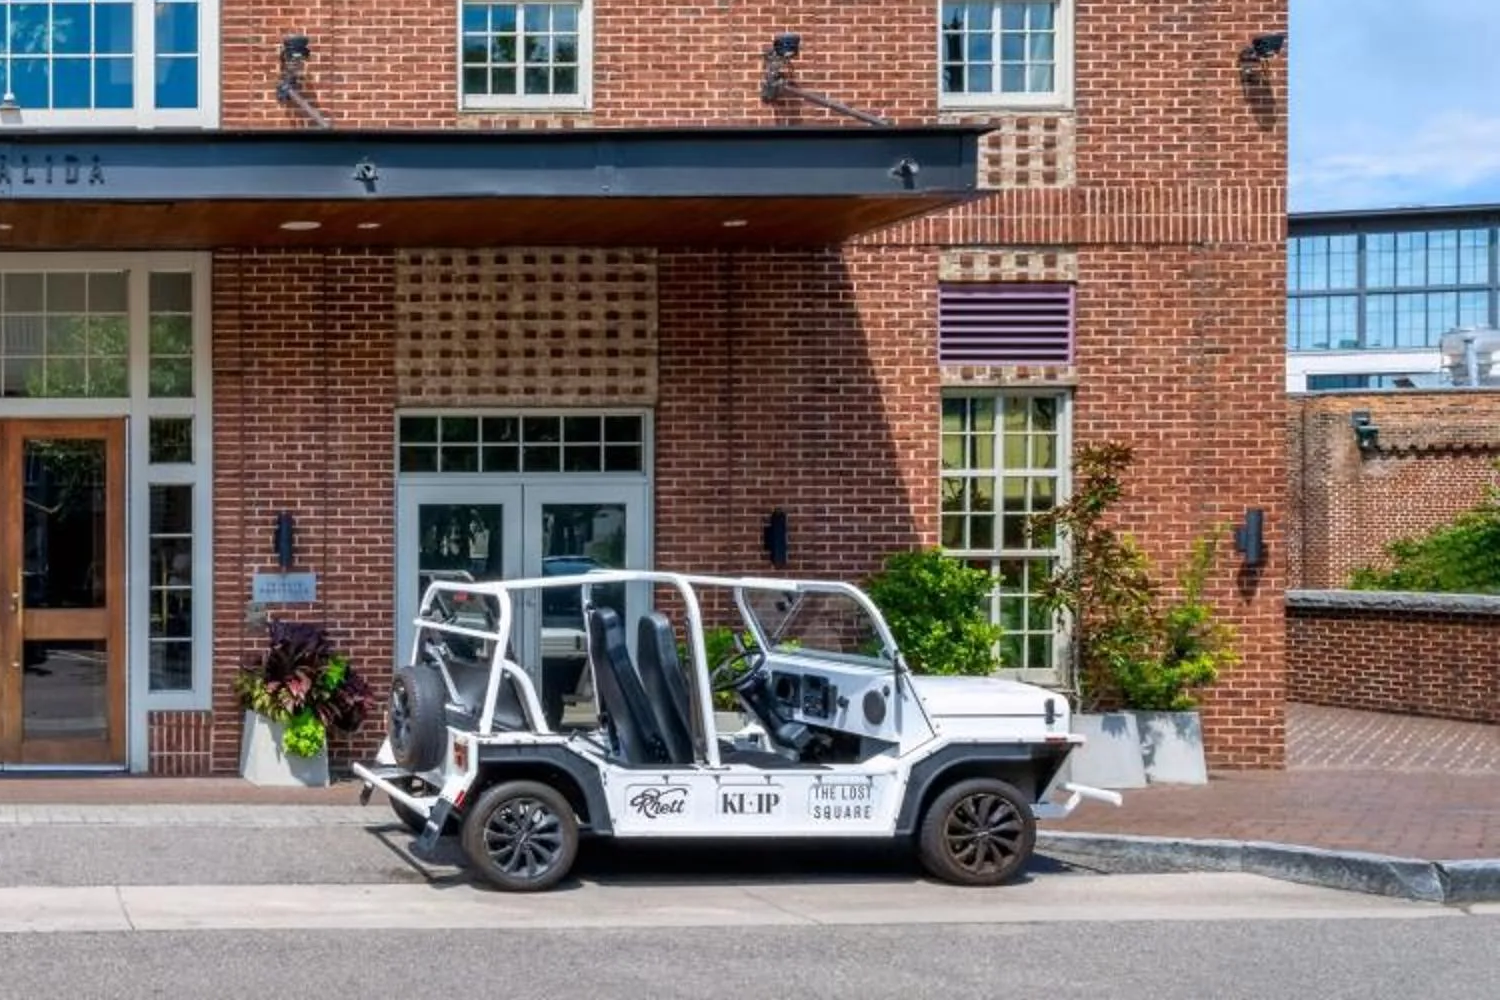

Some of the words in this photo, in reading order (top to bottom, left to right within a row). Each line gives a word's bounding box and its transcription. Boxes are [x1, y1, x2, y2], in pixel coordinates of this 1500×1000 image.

[814, 785, 836, 801] THE
[841, 785, 872, 801] LOST
[813, 805, 872, 820] SQUARE
